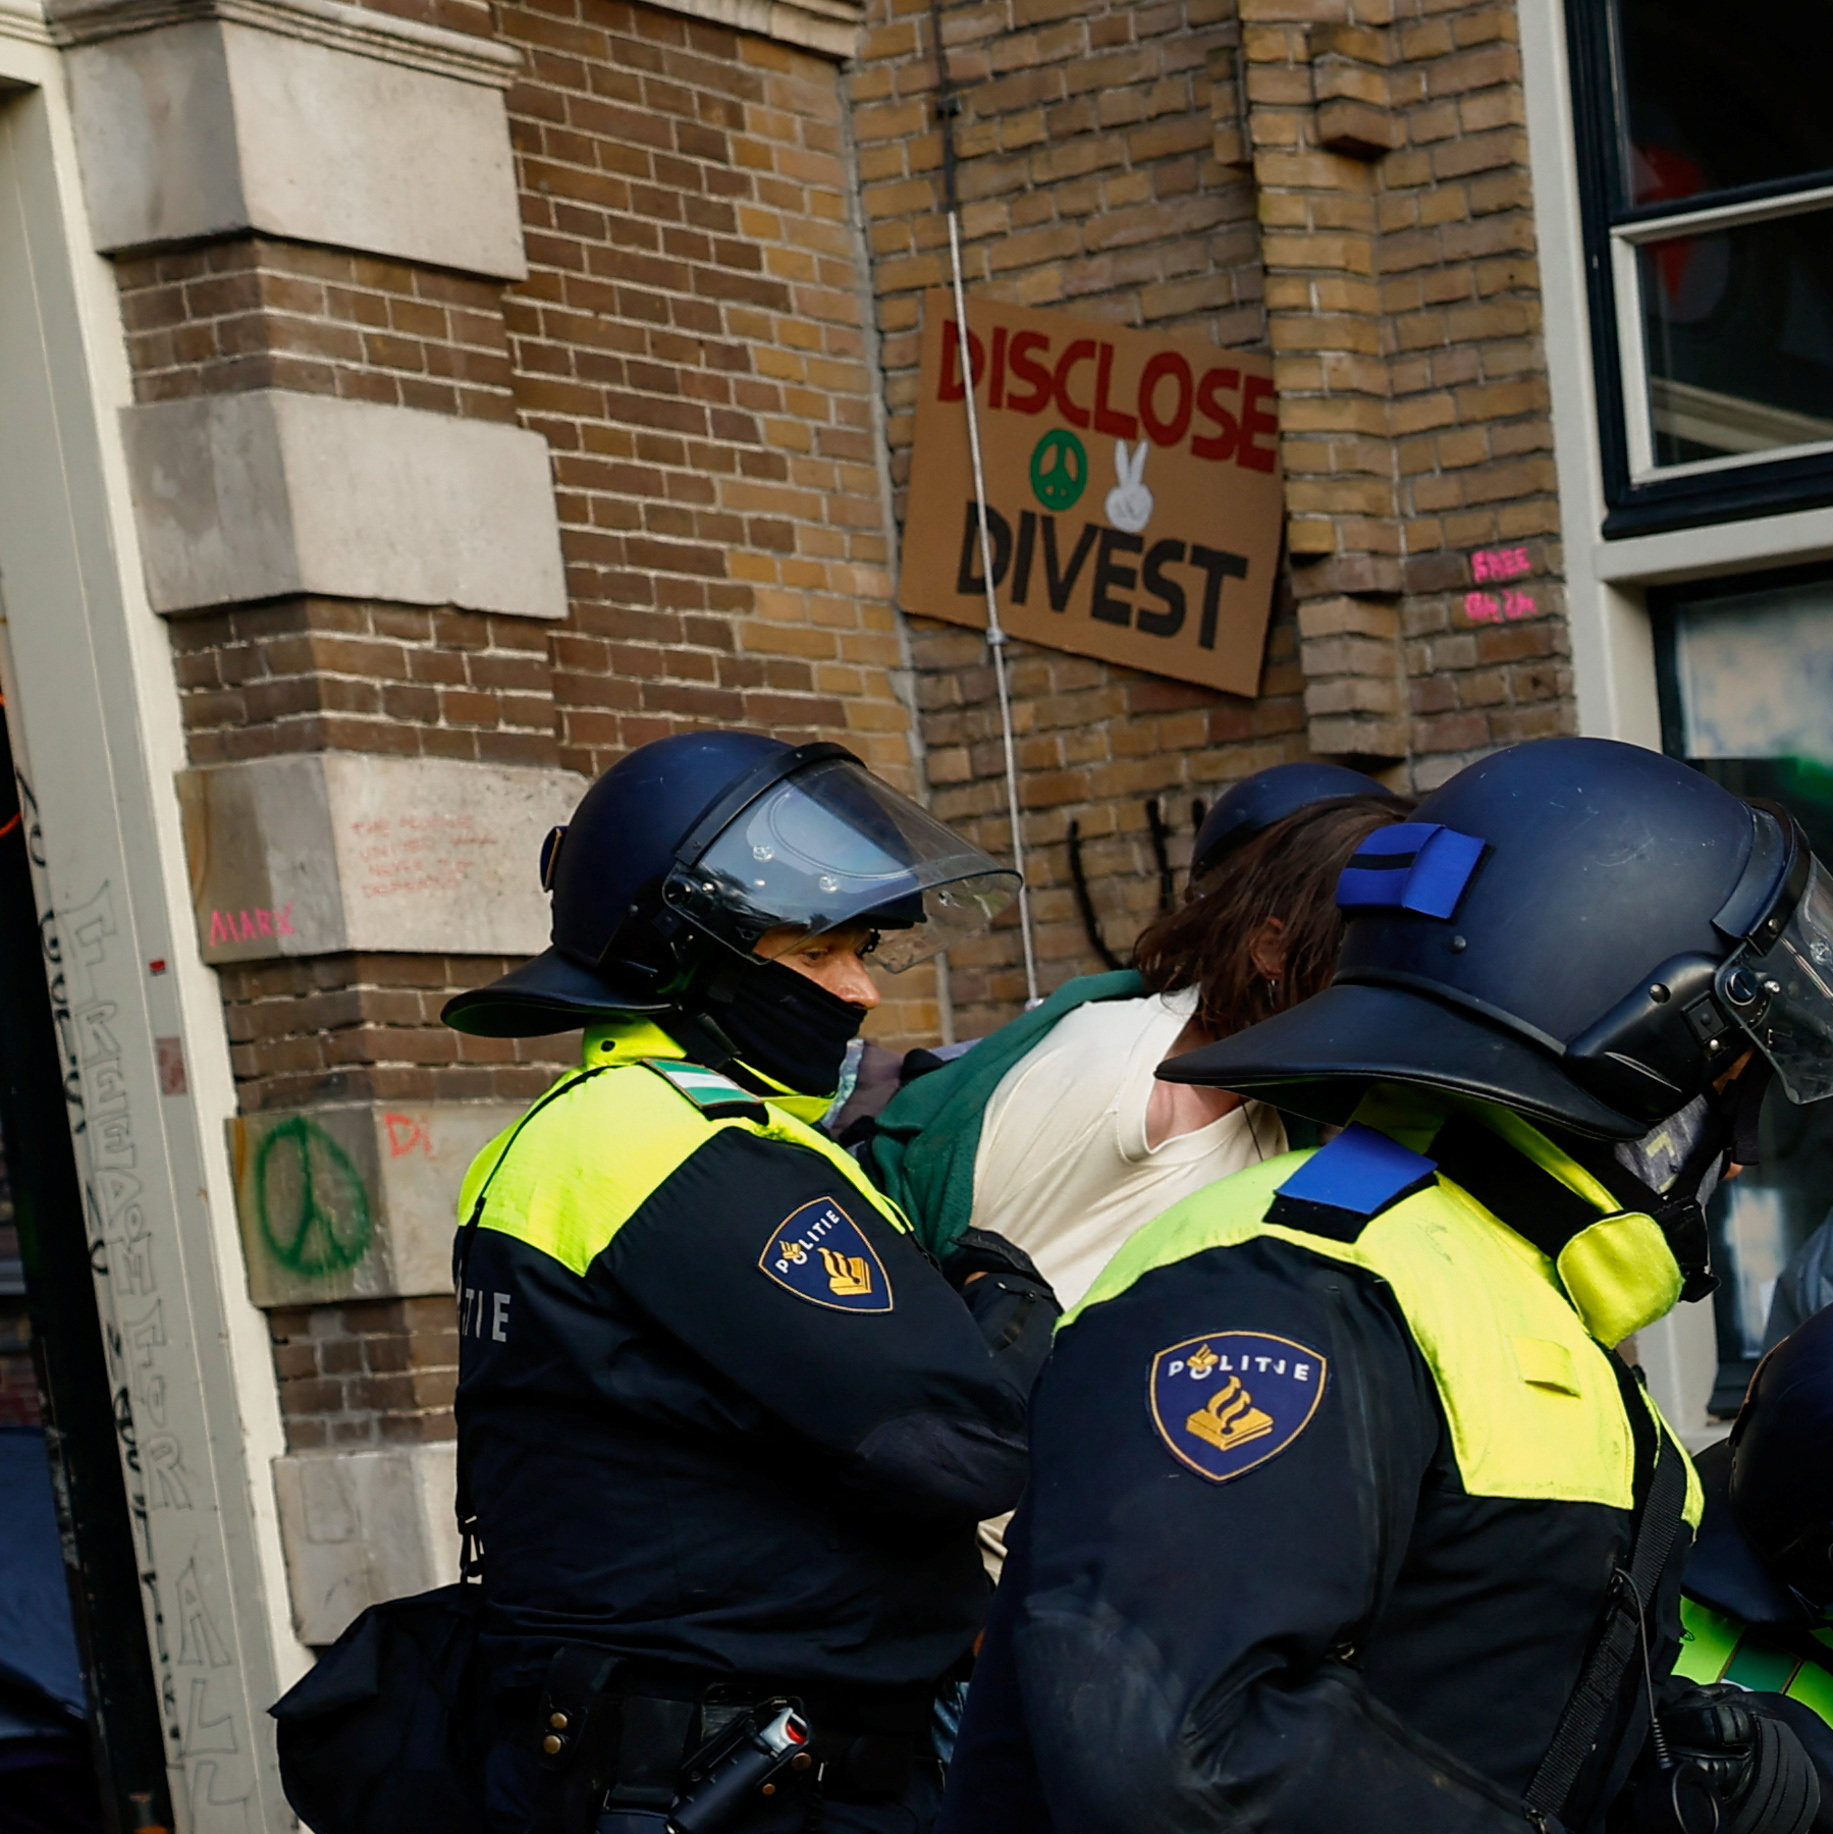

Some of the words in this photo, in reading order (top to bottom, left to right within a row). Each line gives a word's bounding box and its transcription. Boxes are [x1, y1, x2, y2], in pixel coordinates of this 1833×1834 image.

[936, 319, 1279, 474] DISCLOSE
[957, 500, 1249, 650] DIVEST
[1471, 546, 1532, 583] FREE
[209, 902, 297, 948] MARX
[774, 1206, 842, 1276] POLITIE
[1168, 1353, 1311, 1384] POLITIE
